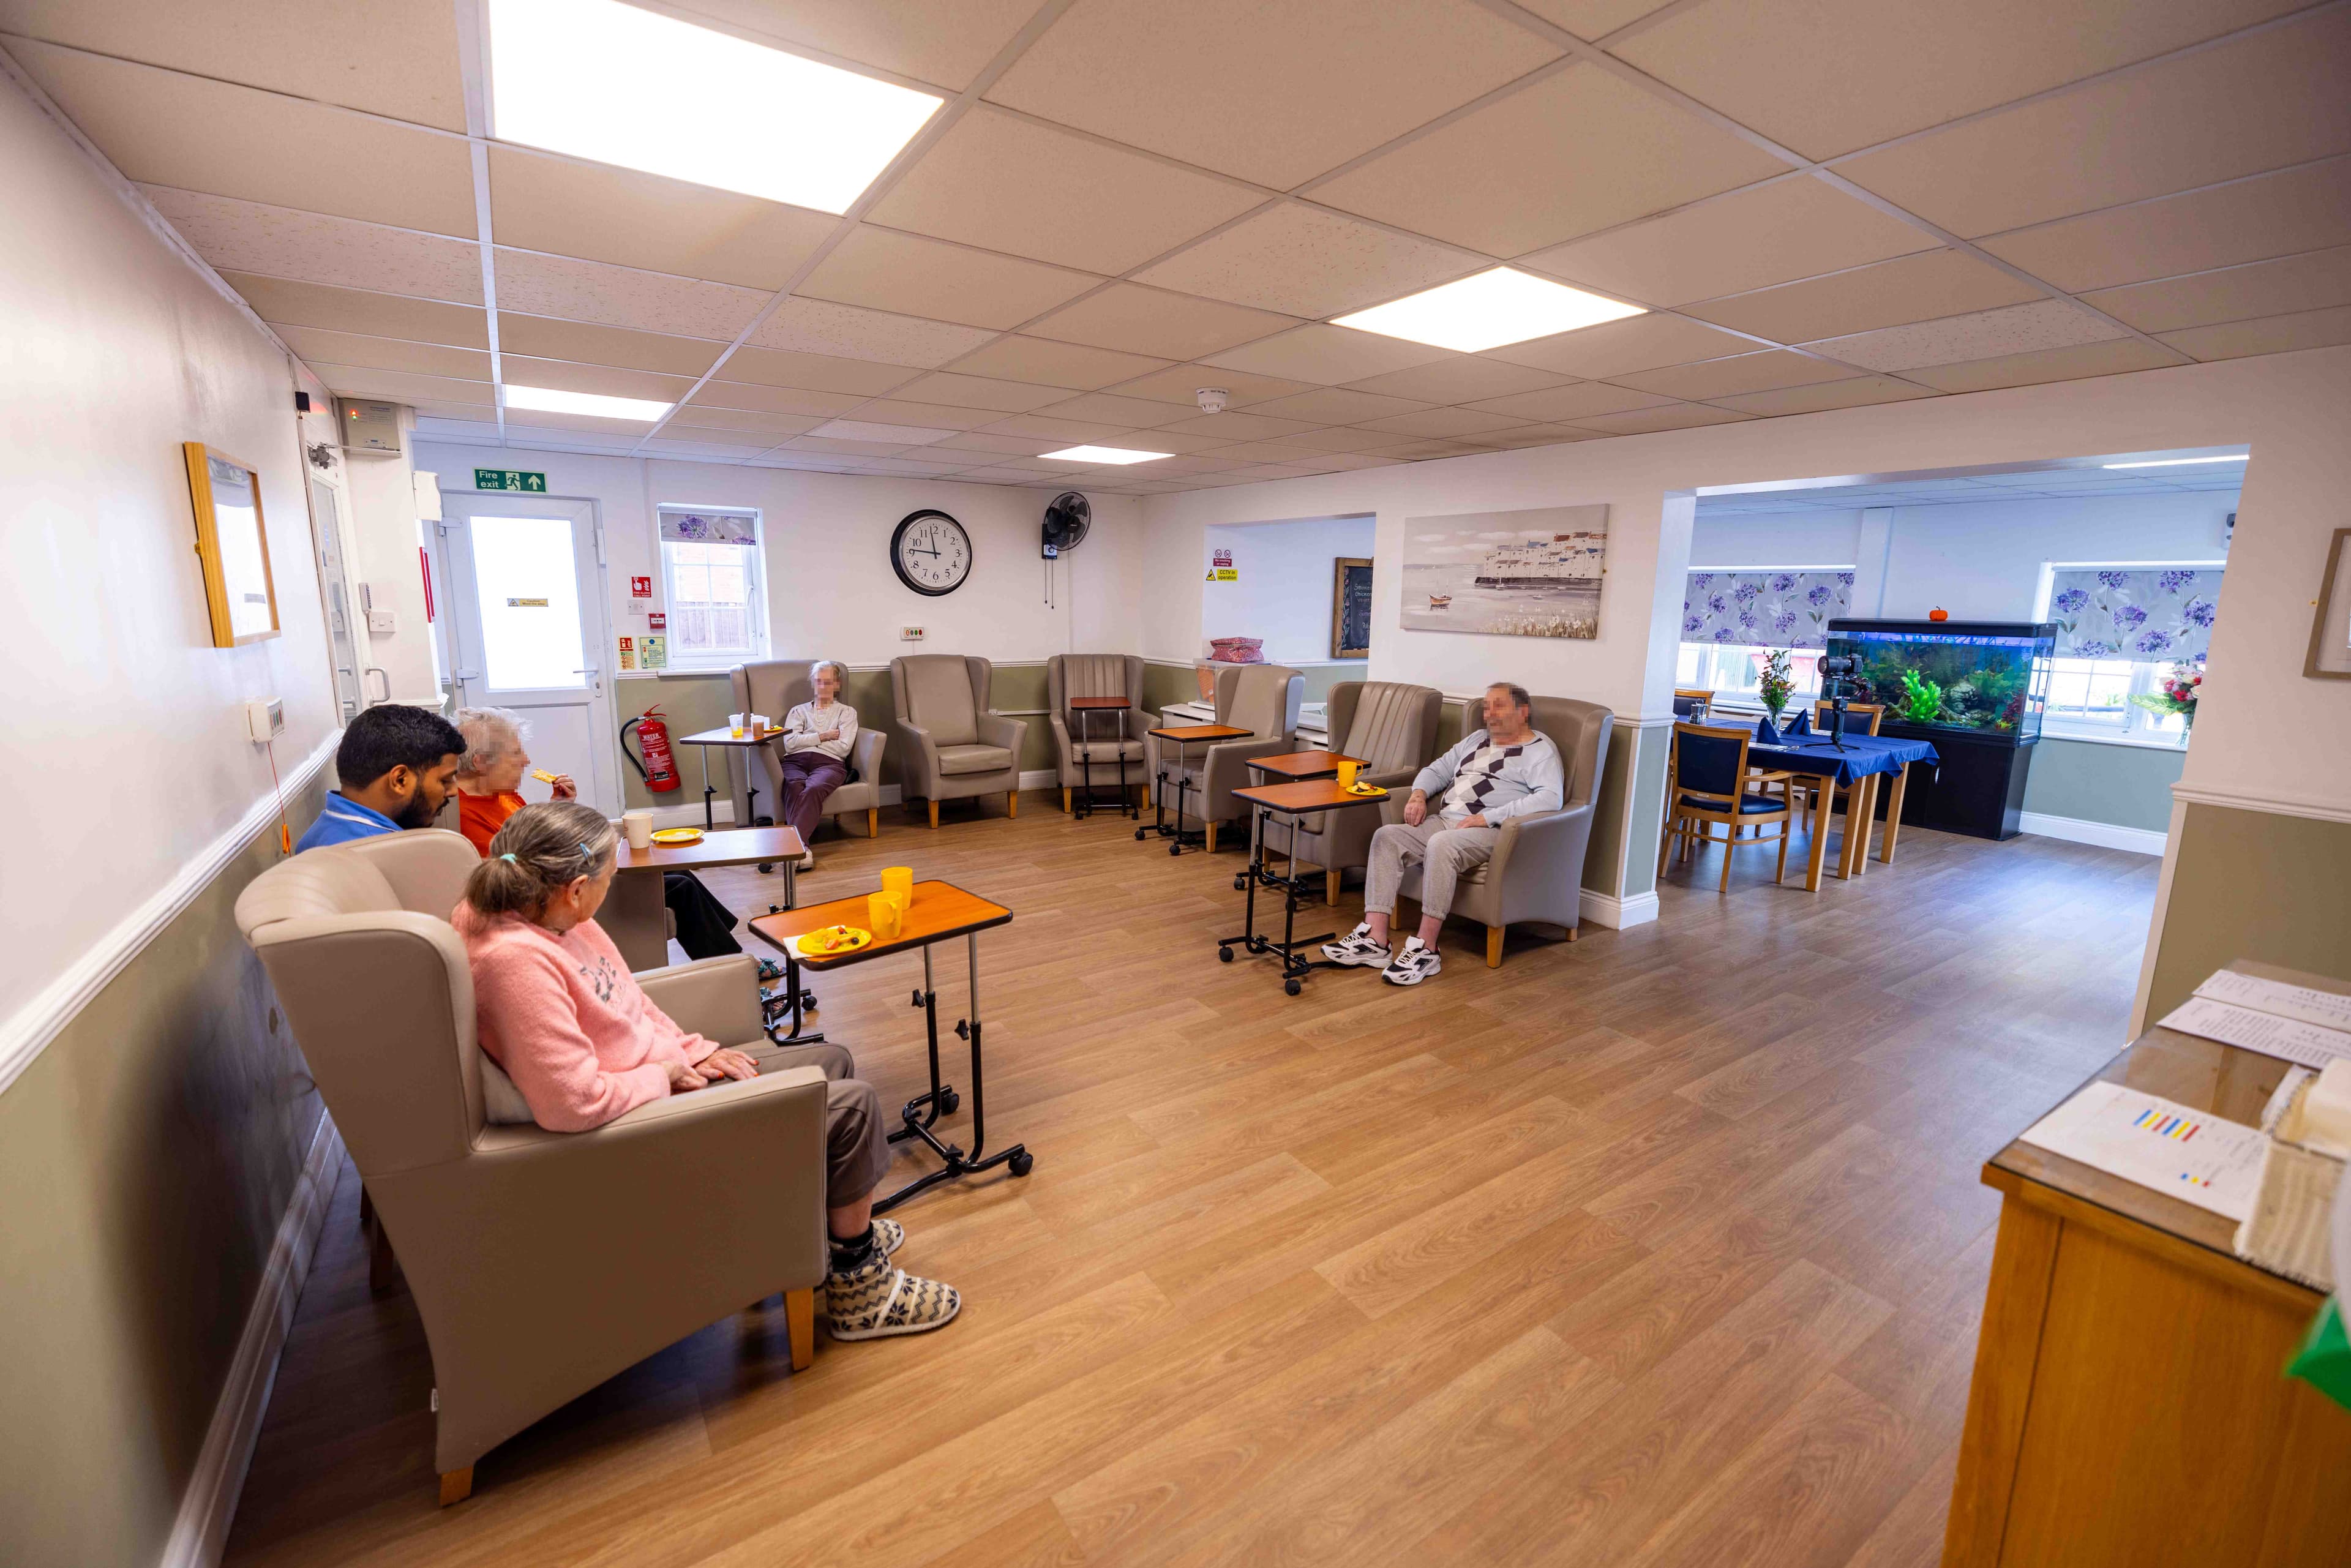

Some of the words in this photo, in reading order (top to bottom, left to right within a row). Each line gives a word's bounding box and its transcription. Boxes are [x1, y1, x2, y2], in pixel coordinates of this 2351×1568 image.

[479, 470, 498, 479] Fire
[913, 538, 921, 547] 10
[909, 549, 915, 557] 9
[955, 549, 961, 558] 3
[913, 560, 919, 569] 8
[951, 560, 957, 569] 4
[932, 571, 939, 580] 6
[945, 569, 950, 577] 5
